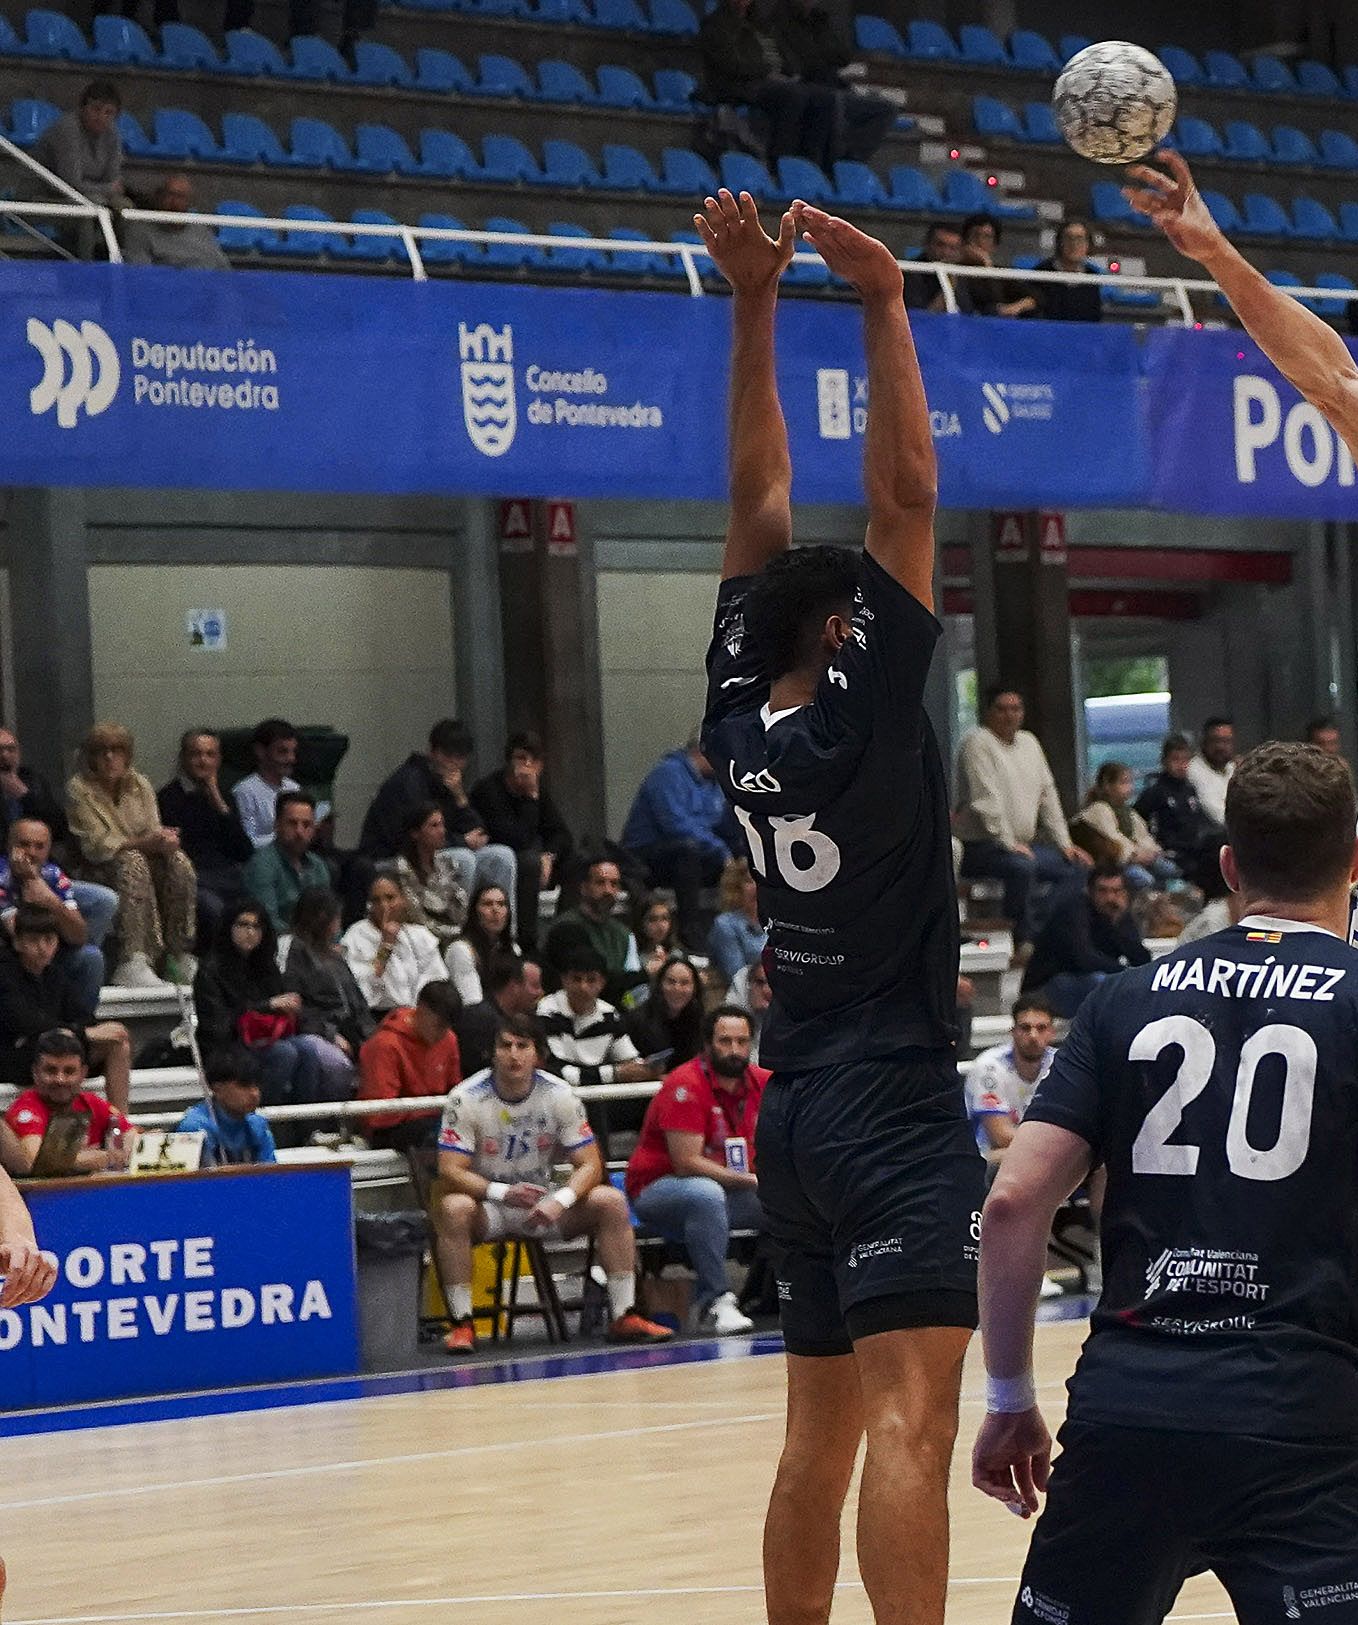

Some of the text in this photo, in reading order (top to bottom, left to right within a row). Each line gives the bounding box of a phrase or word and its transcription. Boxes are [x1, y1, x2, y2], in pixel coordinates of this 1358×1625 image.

[131, 337, 278, 378] Deputación
[134, 374, 280, 410] Pontevedra
[527, 397, 663, 428] de Pontevedra
[1150, 956, 1347, 1001] MARTÍNEZ
[1128, 1015, 1318, 1181] 20
[38, 1236, 216, 1290] ORTE
